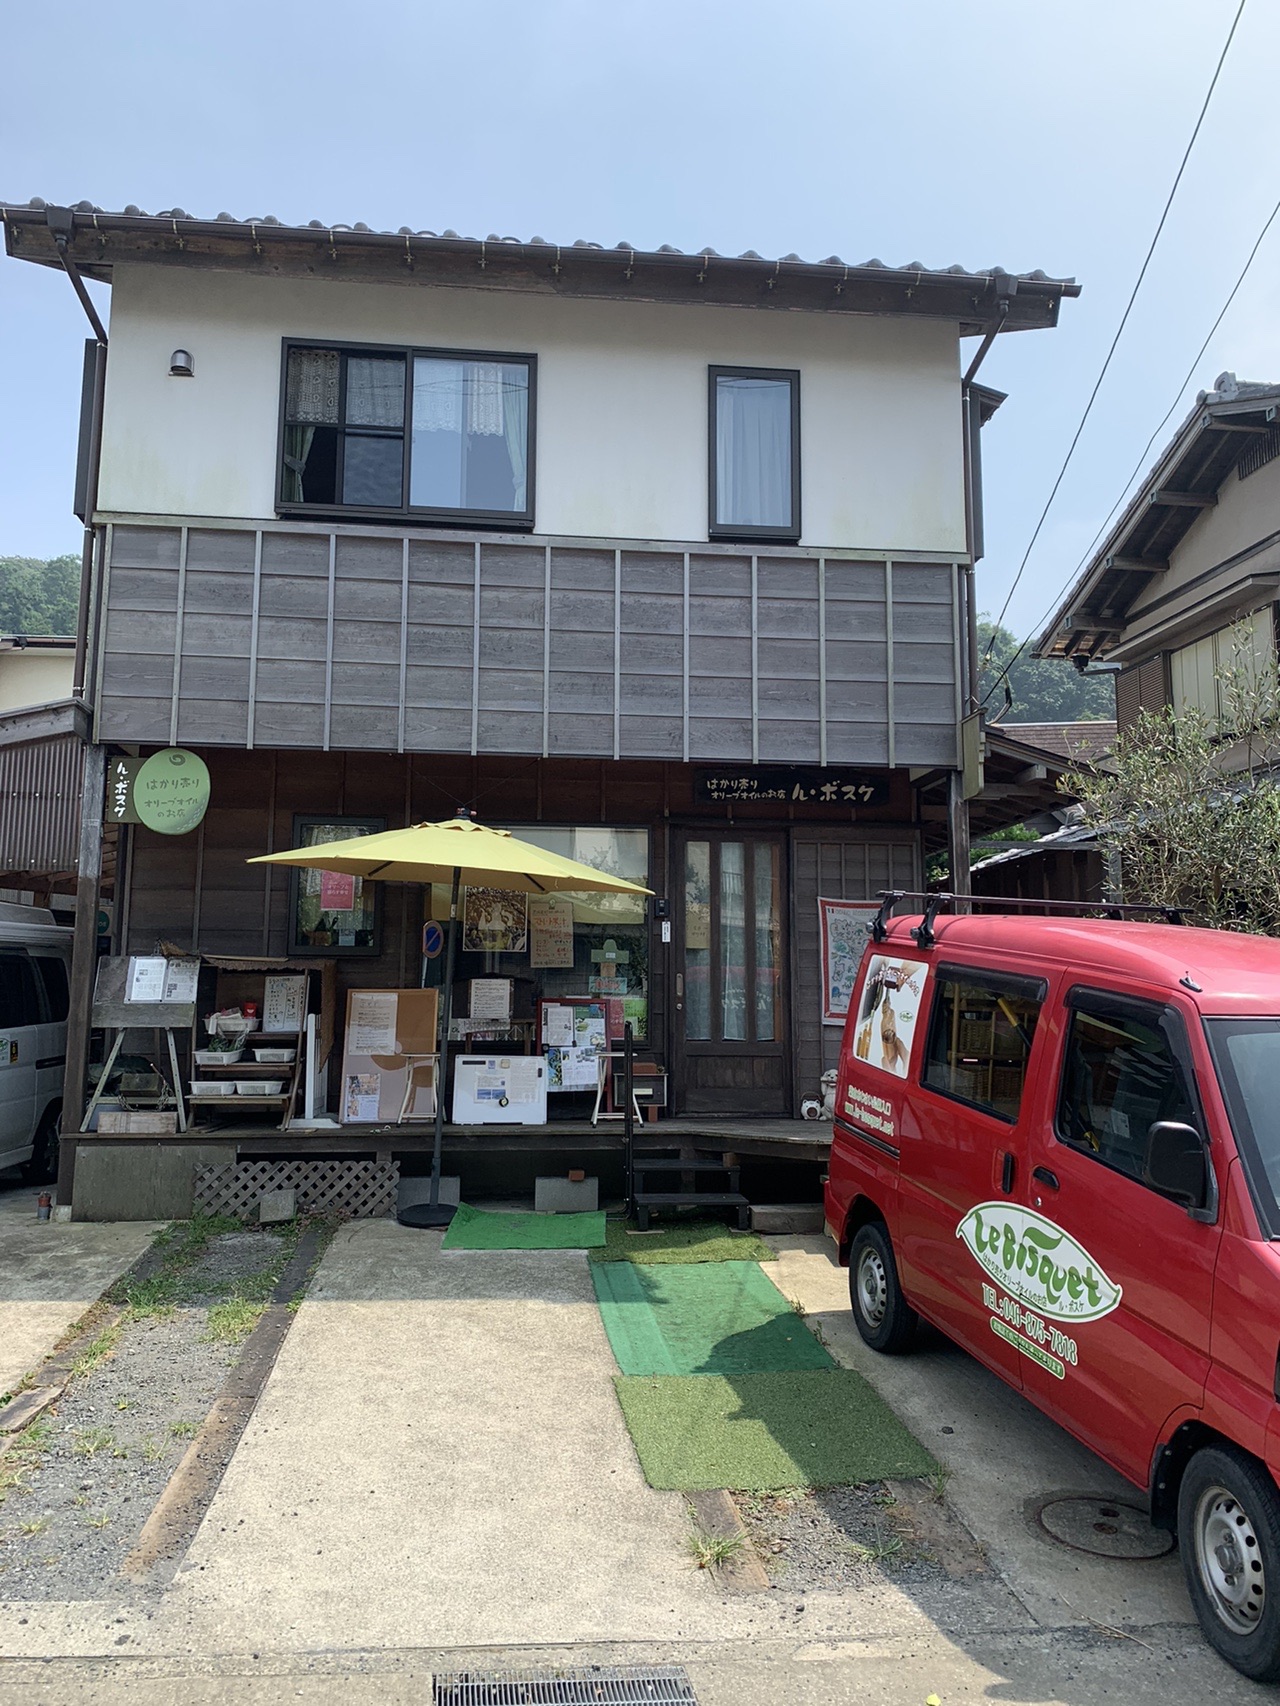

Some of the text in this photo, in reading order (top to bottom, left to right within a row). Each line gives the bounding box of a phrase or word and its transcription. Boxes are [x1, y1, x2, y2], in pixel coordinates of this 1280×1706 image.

[113, 761, 130, 818] ル・ボスケ
[146, 777, 200, 790] はかり売り
[707, 778, 758, 790] はかり売り
[711, 789, 786, 800] オリーブオイルのお店
[791, 780, 875, 802] ル・ボスケ
[144, 796, 199, 808] オリーブオイル
[157, 809, 186, 818] のお店
